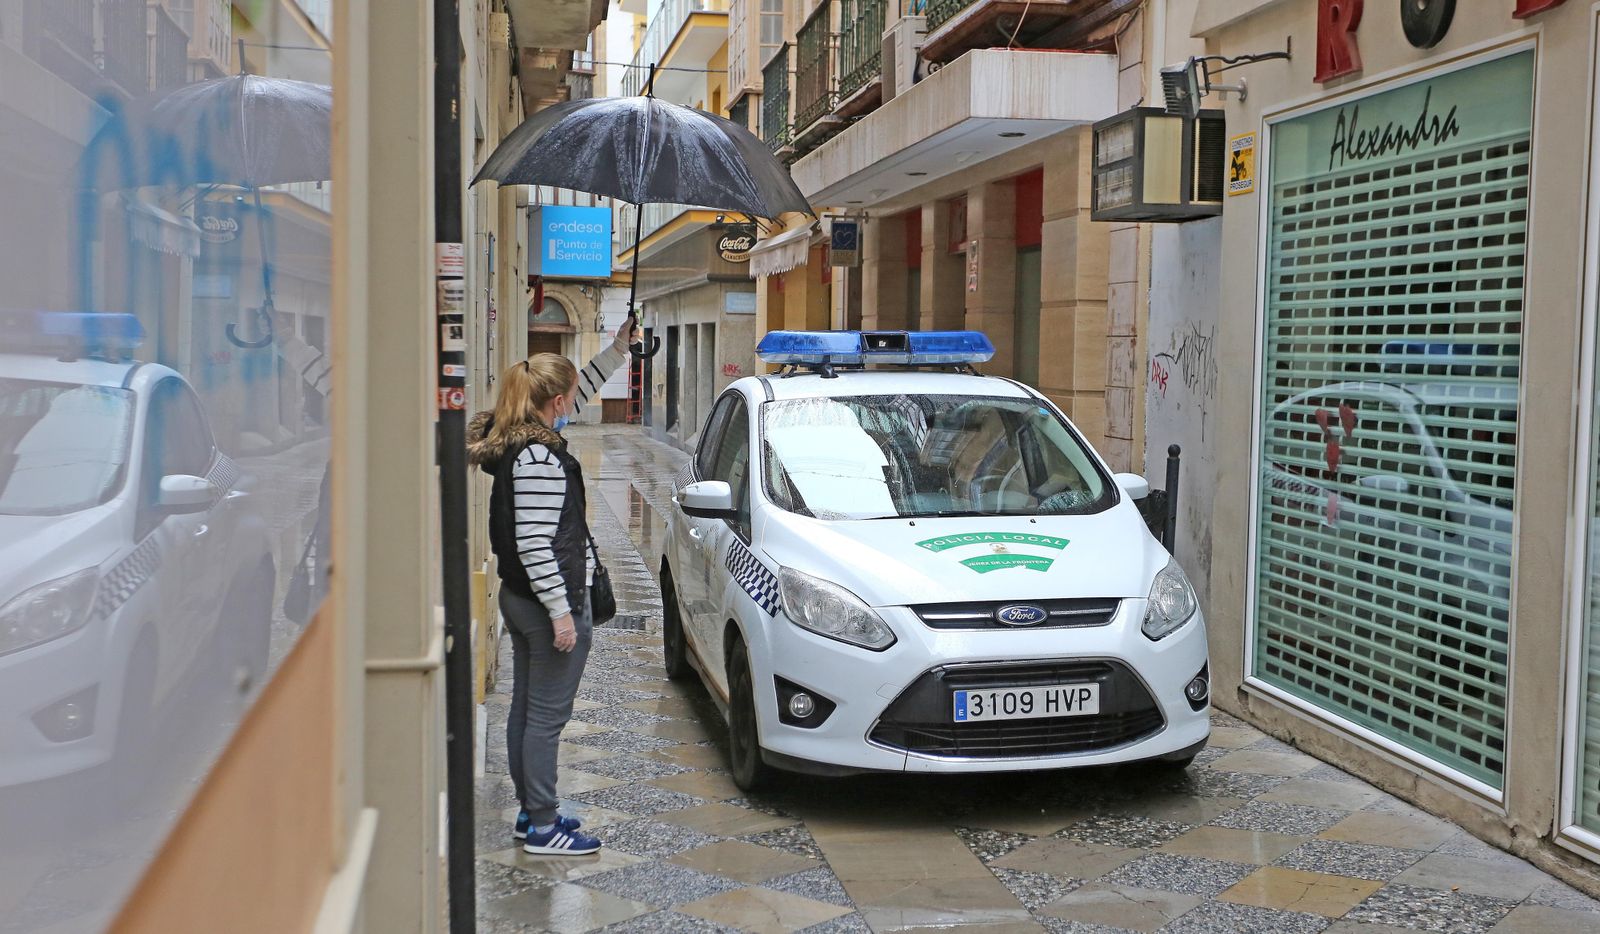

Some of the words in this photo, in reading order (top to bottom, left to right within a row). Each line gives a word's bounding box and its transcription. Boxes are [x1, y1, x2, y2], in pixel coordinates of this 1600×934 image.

[1329, 85, 1460, 172] Alexandra
[1230, 179, 1252, 190] PROSEGUR
[548, 220, 603, 233] endesa
[556, 240, 587, 250] Punto
[590, 240, 602, 250] de
[556, 250, 602, 261] Servicio
[1003, 534, 1063, 547] LOCAL
[1008, 608, 1035, 621] Ford
[958, 709, 964, 717] E
[970, 691, 1034, 717] 3109
[1046, 688, 1092, 713] HVP
